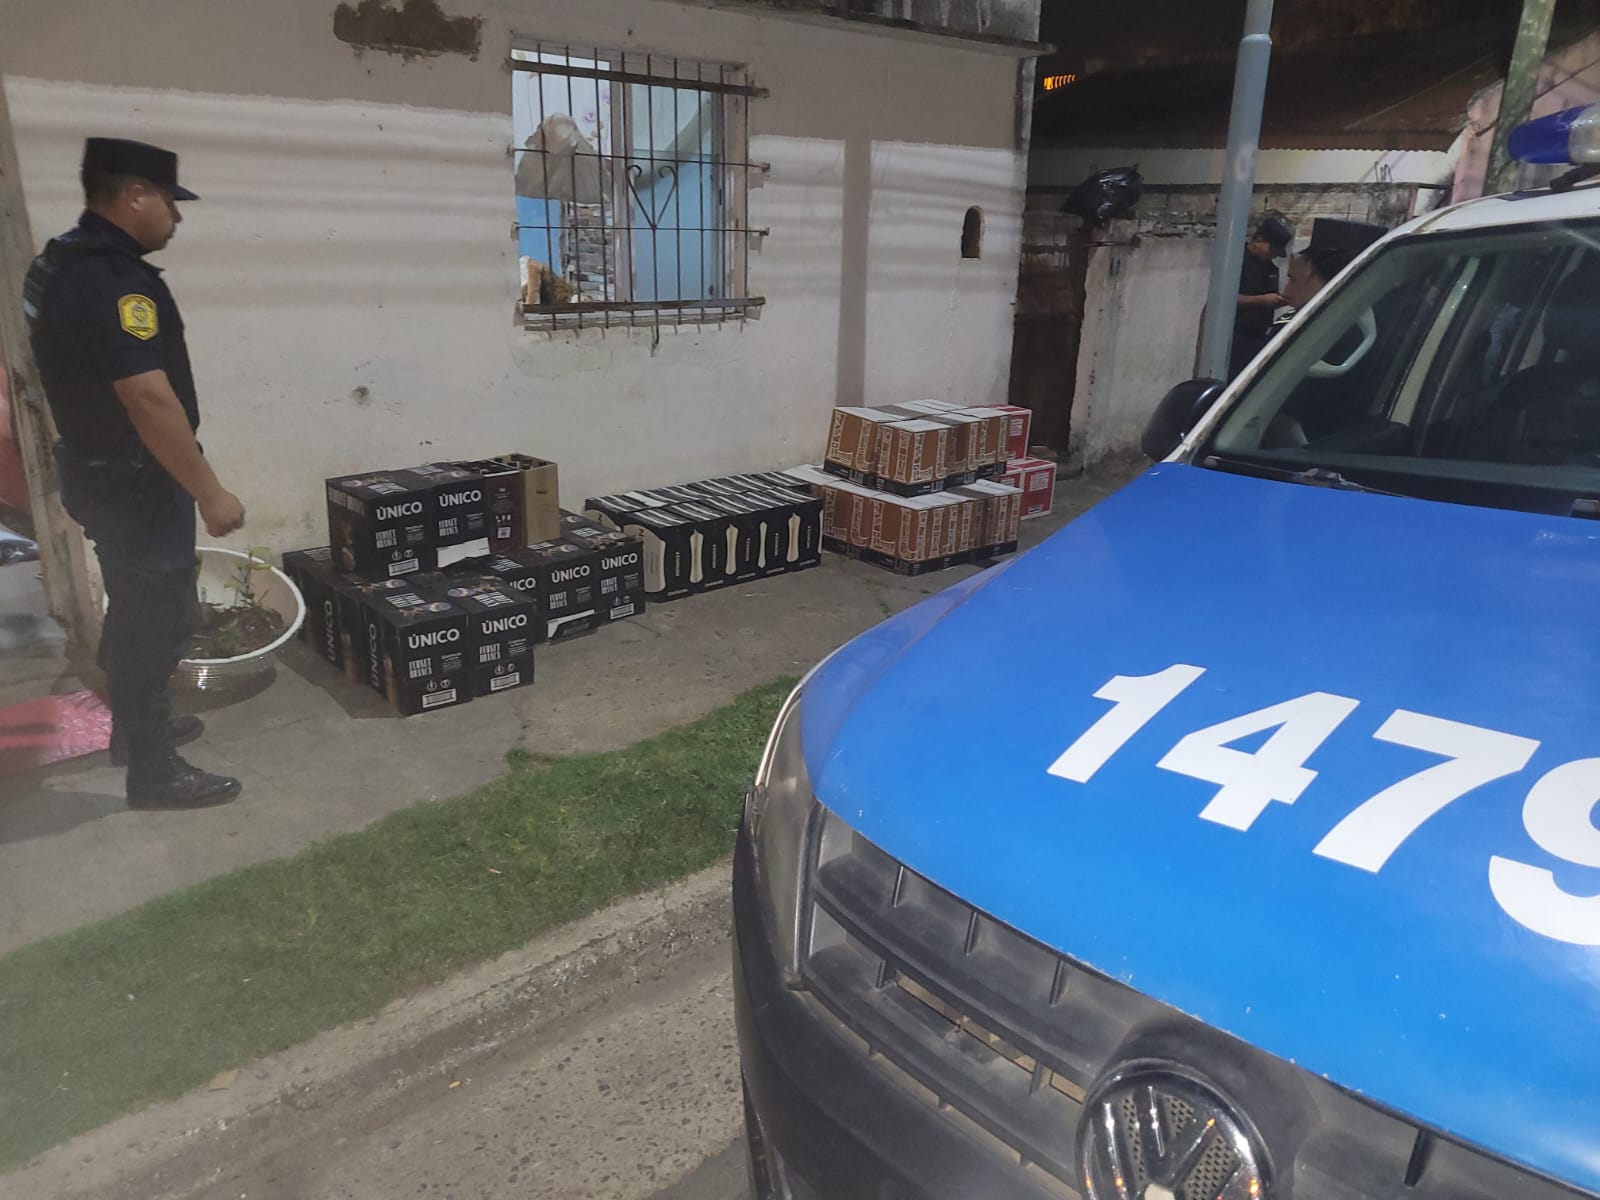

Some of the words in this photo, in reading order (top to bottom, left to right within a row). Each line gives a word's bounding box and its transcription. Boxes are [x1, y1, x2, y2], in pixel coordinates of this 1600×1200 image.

[439, 490, 482, 507] ÚNICO
[376, 501, 423, 521] ÚNICO
[601, 552, 638, 570] ÚNICO
[551, 565, 591, 583] ÚNICO
[481, 614, 528, 635] ÚNICO
[408, 628, 460, 649] ÚNICO
